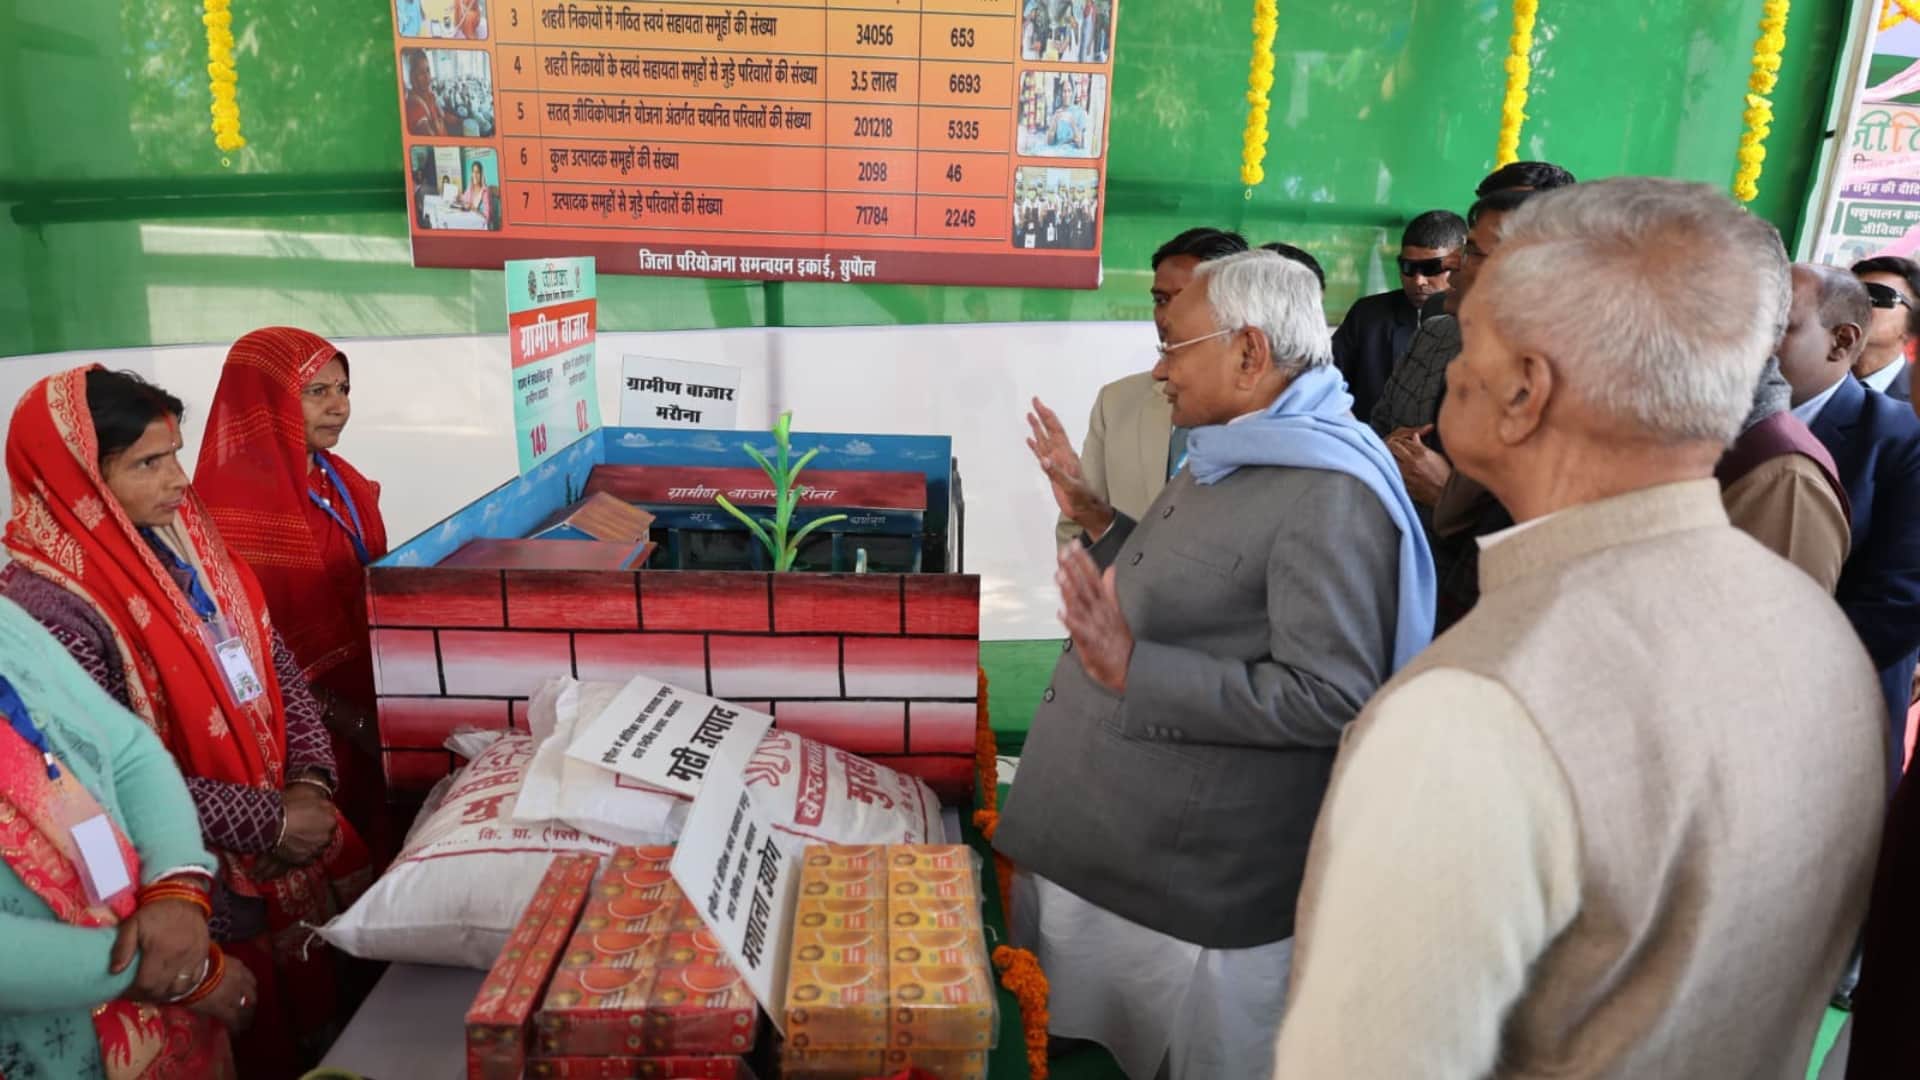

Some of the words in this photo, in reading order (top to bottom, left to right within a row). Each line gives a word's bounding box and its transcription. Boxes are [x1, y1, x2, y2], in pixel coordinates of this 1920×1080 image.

[510, 8, 518, 27] 3
[541, 4, 565, 29] शहरी
[567, 4, 603, 30] निकायों
[604, 5, 614, 30] में
[615, 6, 641, 31] गठित
[643, 8, 664, 32] स्वयं
[666, 13, 703, 34] सहायता
[704, 9, 732, 41] समूहों
[733, 10, 748, 35] की
[749, 12, 778, 36] संख्या
[856, 24, 894, 46] 34056
[950, 28, 976, 48] 653
[513, 55, 522, 74] 4
[544, 50, 568, 76] शहरी
[570, 51, 605, 77] निकायों
[606, 52, 618, 76] के
[619, 55, 641, 78] स्वयं
[642, 59, 680, 80] सहायता
[681, 56, 708, 88] समूहों
[709, 56, 718, 81] से
[721, 57, 736, 89] जुड़े
[737, 58, 772, 83] परिवारों
[775, 58, 789, 83] की
[790, 61, 818, 84] संख्या
[851, 71, 868, 92] 3.5
[870, 71, 898, 92] लाख
[949, 74, 981, 94] 6693
[517, 101, 525, 121] 5
[546, 103, 572, 126] सतत्
[572, 98, 632, 124] जीविकोपार्जन
[633, 100, 663, 125] योजना
[665, 101, 696, 126] अंतर्गत
[697, 103, 731, 127] चयनित
[732, 104, 768, 128] परिवारों
[768, 104, 783, 129] की
[784, 106, 812, 130] संख्या
[853, 117, 894, 138] 201218
[948, 120, 980, 141] 5335
[520, 147, 528, 167] 6
[549, 148, 569, 173] कुल
[571, 149, 608, 168] उत्पादक
[609, 144, 636, 175] समूहों
[636, 145, 651, 170] की
[652, 147, 680, 171] संख्या
[858, 161, 888, 182] 2098
[945, 164, 963, 183] 46
[522, 191, 531, 210] 7
[551, 193, 589, 211] उत्पादक
[591, 188, 617, 218] समूहों
[617, 189, 627, 212] से
[627, 190, 644, 220] जुड़े
[645, 190, 680, 214] परिवारों
[680, 191, 695, 215] की
[696, 193, 724, 216] संख्या
[855, 205, 889, 226] 71784
[945, 208, 976, 228] 2246
[639, 249, 673, 271] जिला
[676, 251, 736, 273] परियोजना
[739, 255, 794, 275] समन्वयन
[798, 253, 835, 280] इकाई,
[839, 255, 878, 282] सुपौल
[519, 313, 559, 360] ग्रामीण
[560, 312, 590, 346] बाजार
[626, 376, 684, 396] ग्रामीण
[686, 383, 736, 402] बाजार
[530, 423, 548, 459] 143
[690, 704, 740, 750] उत्पाद
